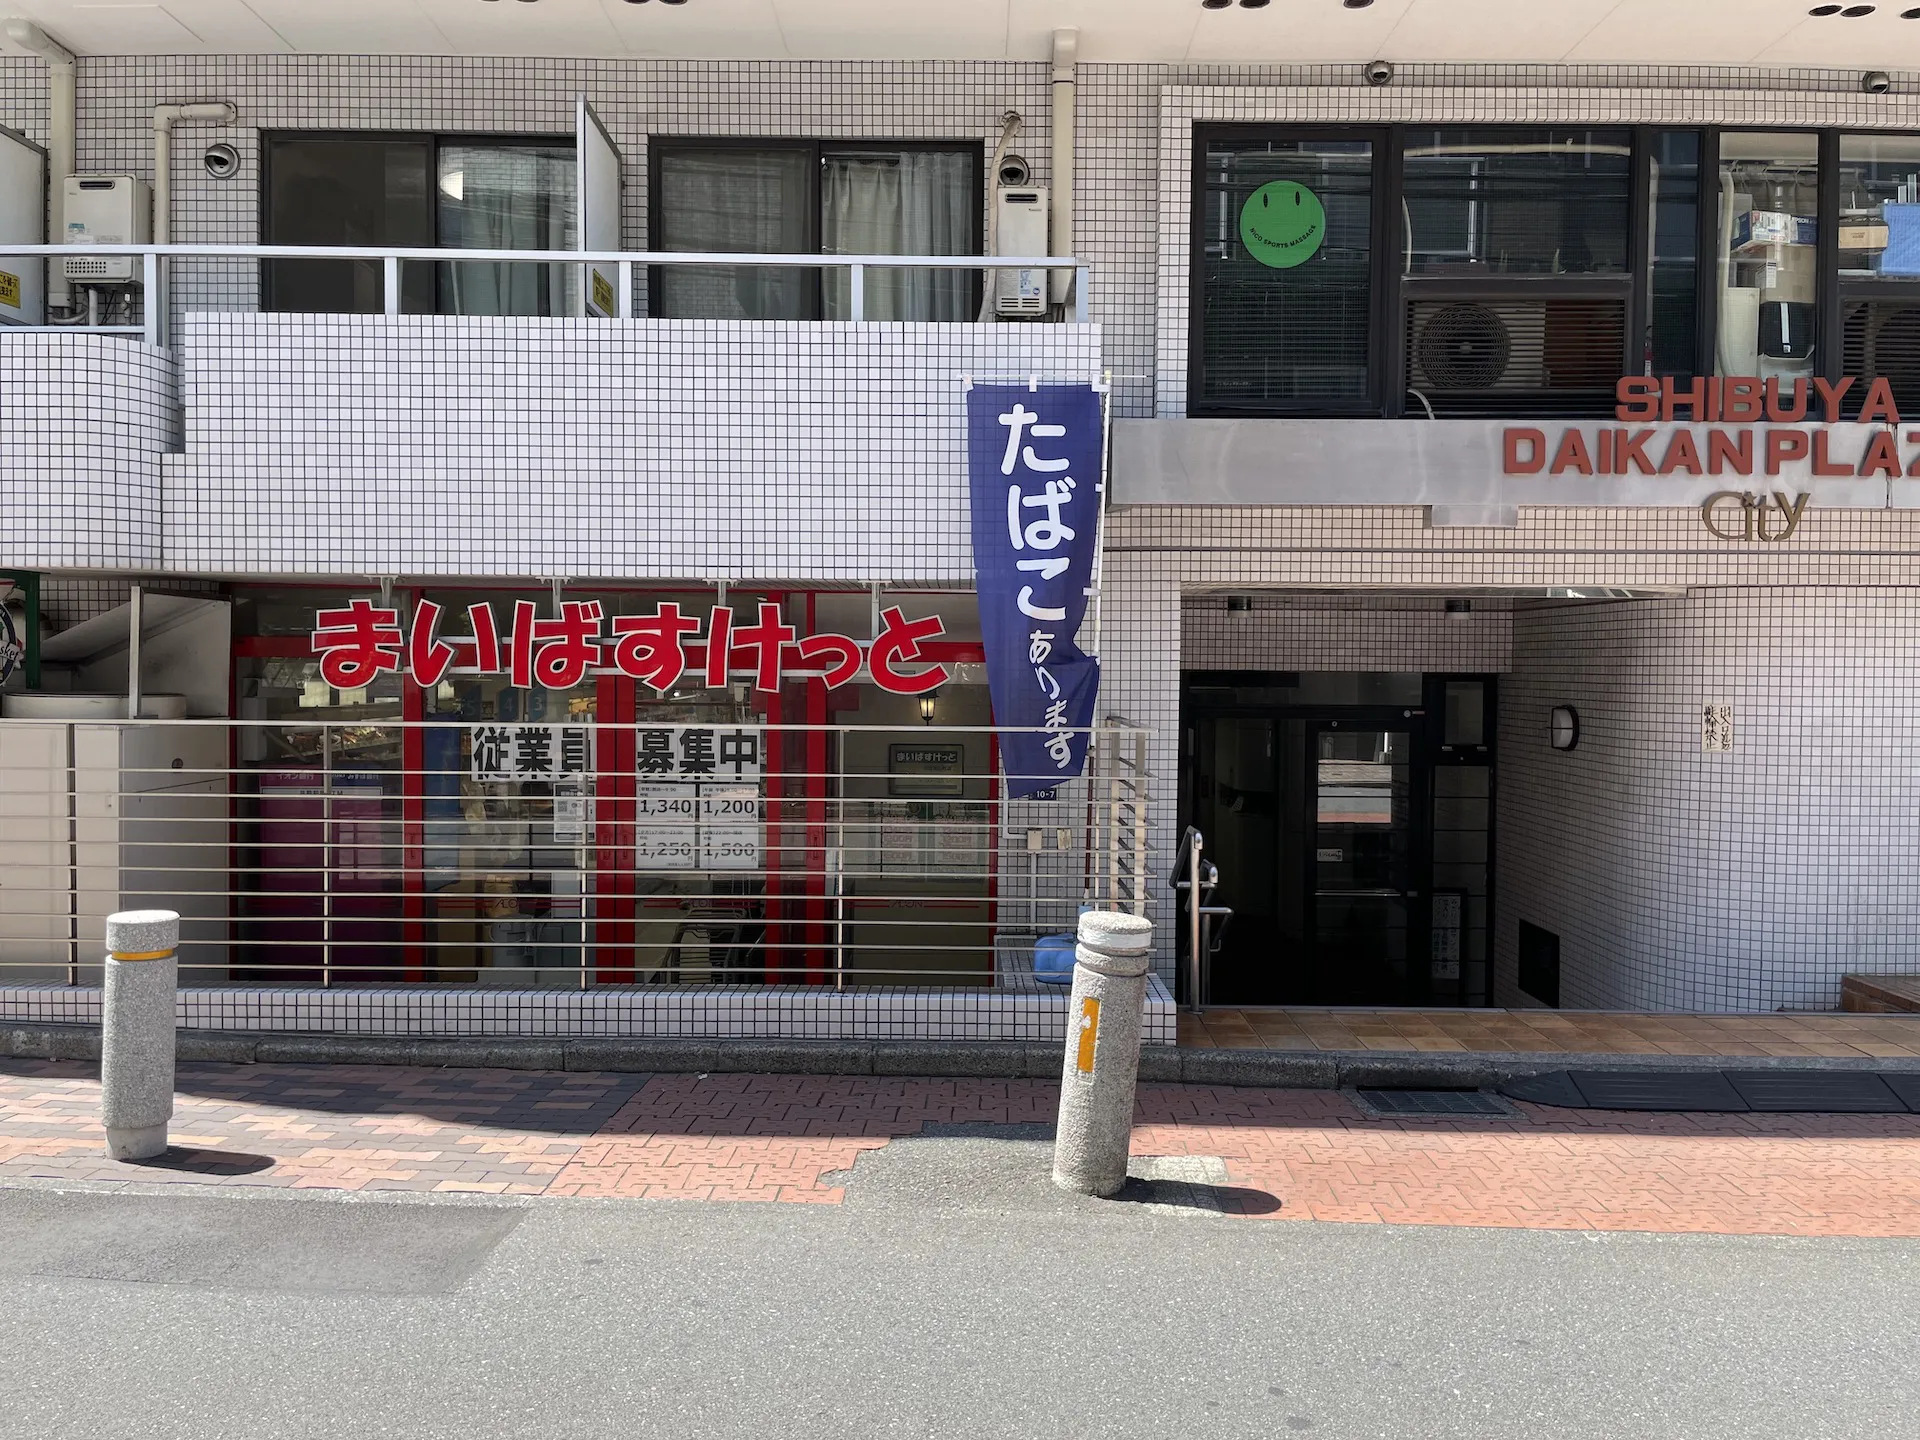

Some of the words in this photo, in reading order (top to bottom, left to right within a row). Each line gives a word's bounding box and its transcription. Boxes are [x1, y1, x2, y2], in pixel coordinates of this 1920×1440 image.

[1264, 239, 1288, 249] SPORTS
[1290, 225, 1316, 246] MASSAGE
[1616, 376, 1899, 423] SHIBUYA
[1701, 490, 1811, 542] City
[311, 598, 950, 694] まいばすけっと
[473, 726, 592, 780] 従業員
[637, 727, 757, 780] 募集中
[1036, 790, 1055, 799] 10-7
